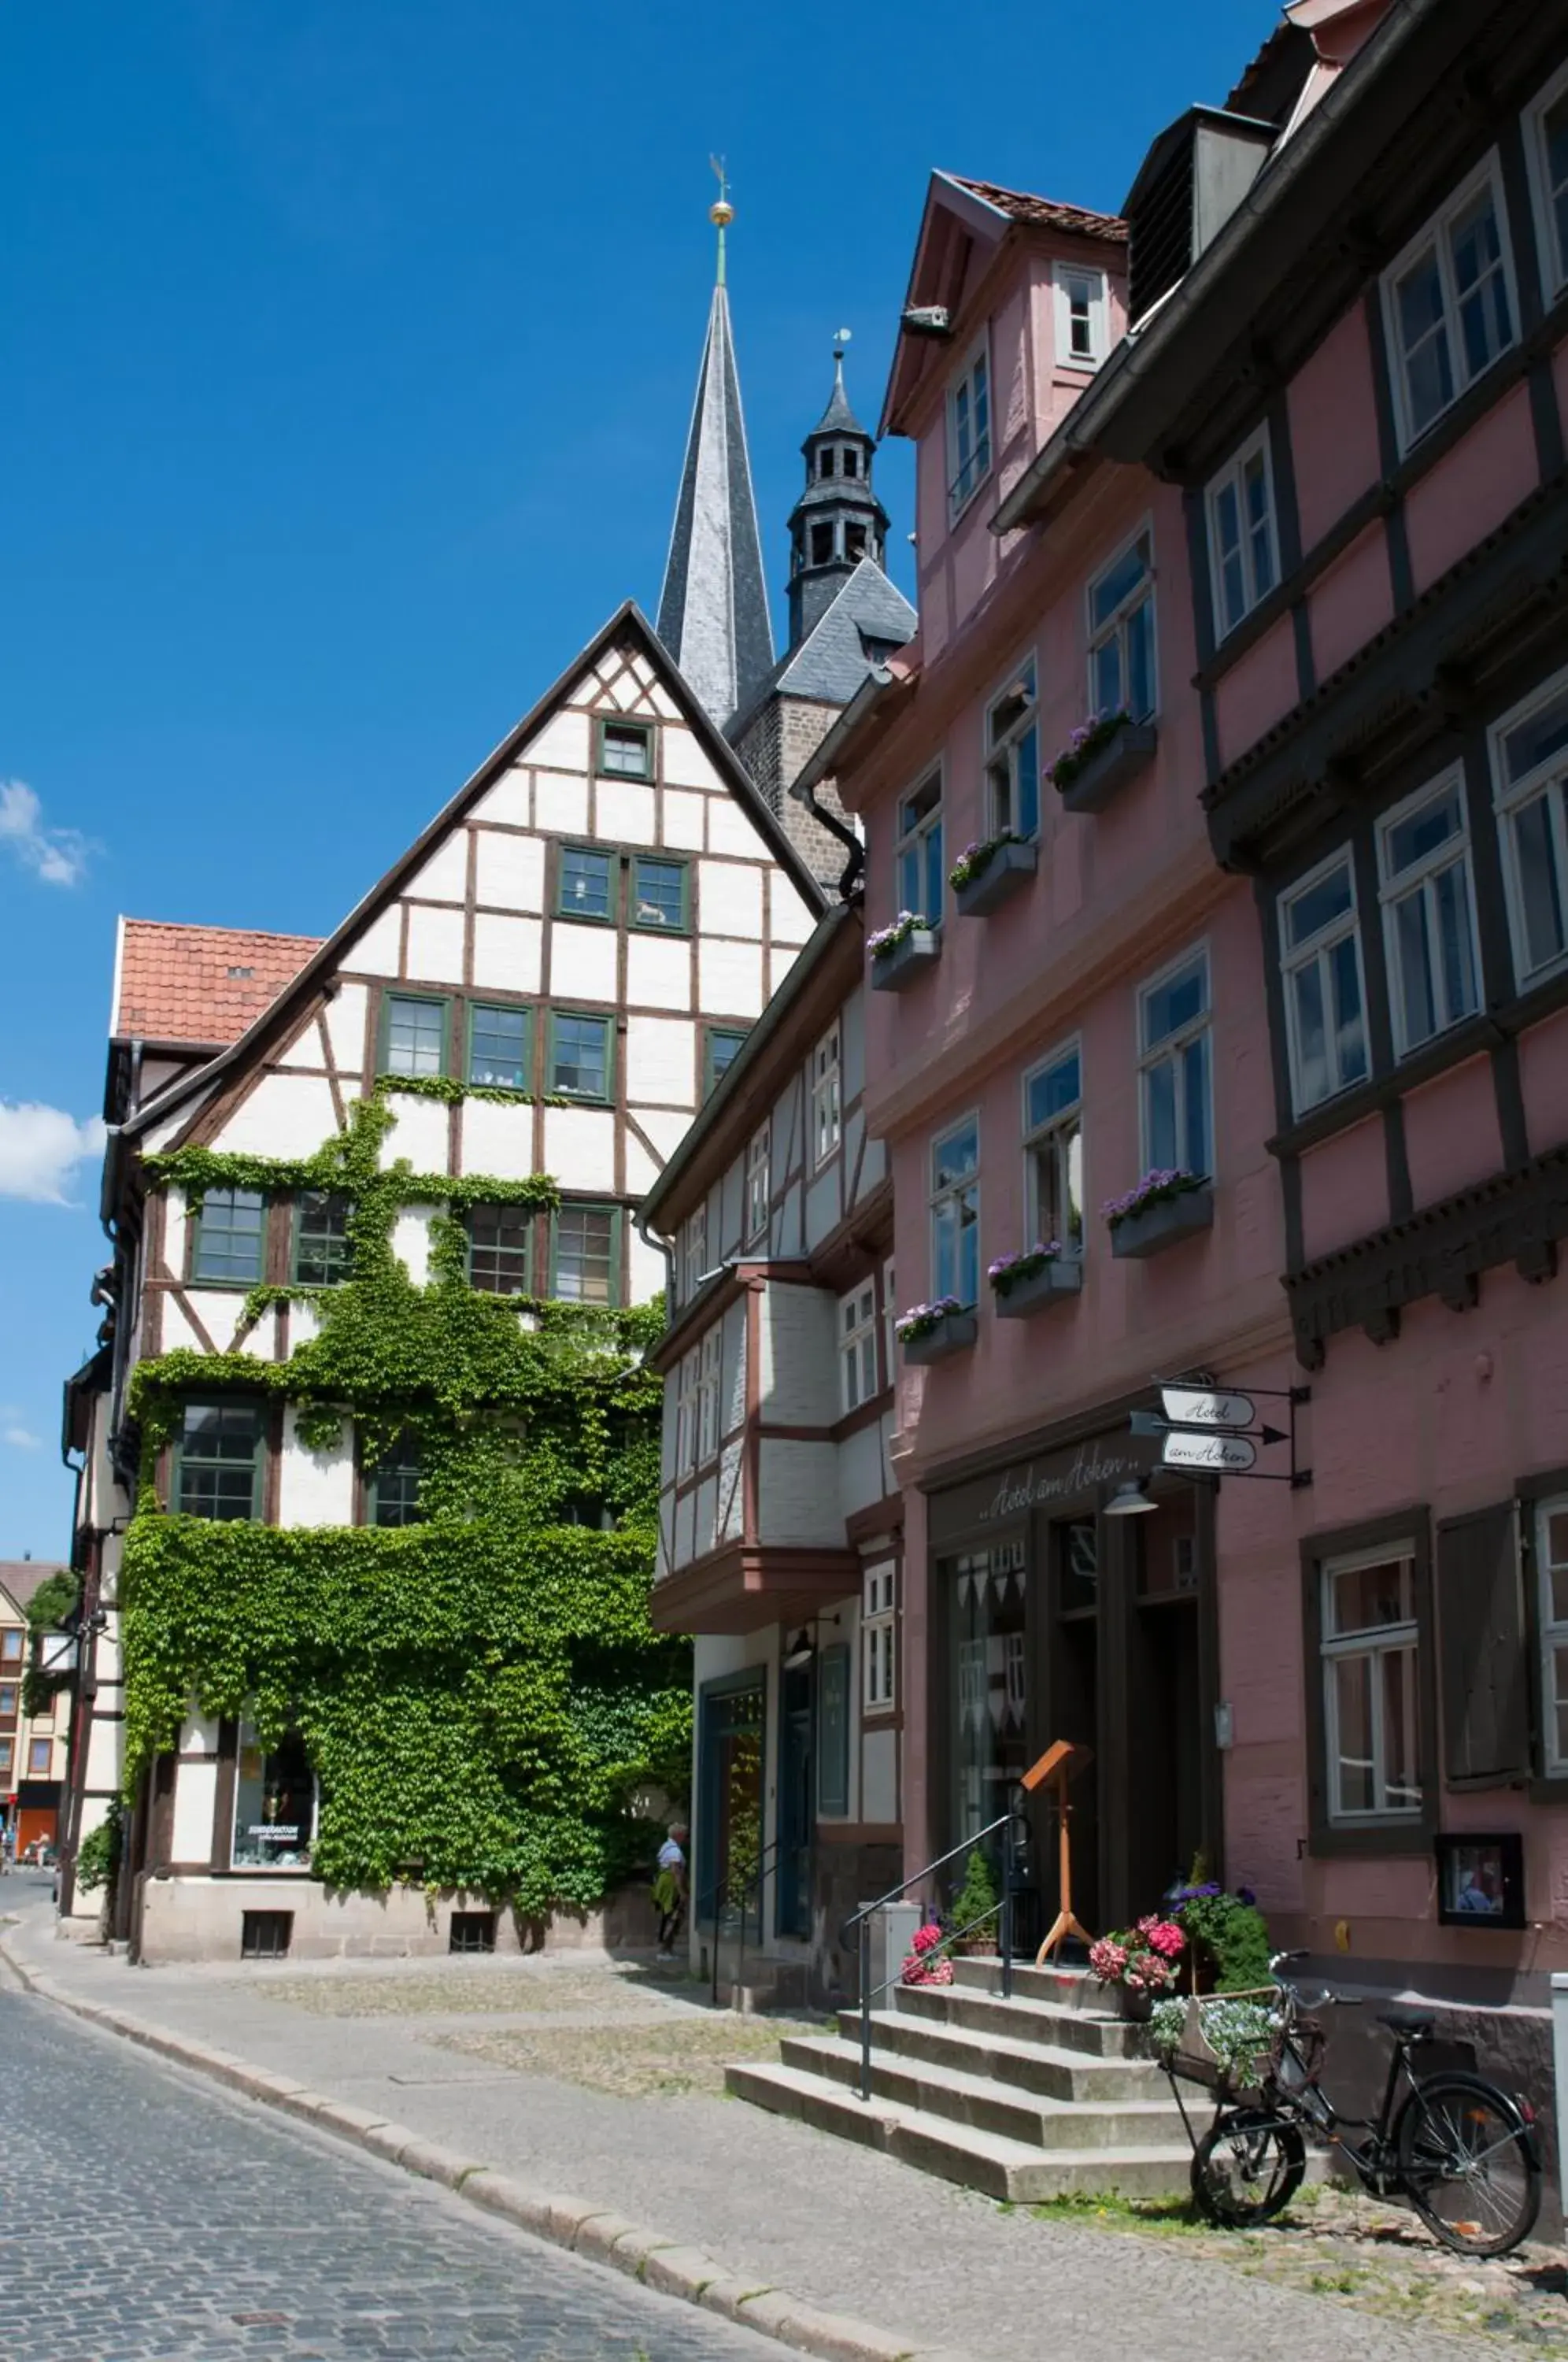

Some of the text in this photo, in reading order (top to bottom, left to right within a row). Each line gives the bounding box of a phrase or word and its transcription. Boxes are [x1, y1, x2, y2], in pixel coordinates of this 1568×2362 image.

[1185, 1398, 1230, 1420] Hotel
[1169, 1448, 1195, 1458] am
[1037, 1478, 1063, 1500] am
